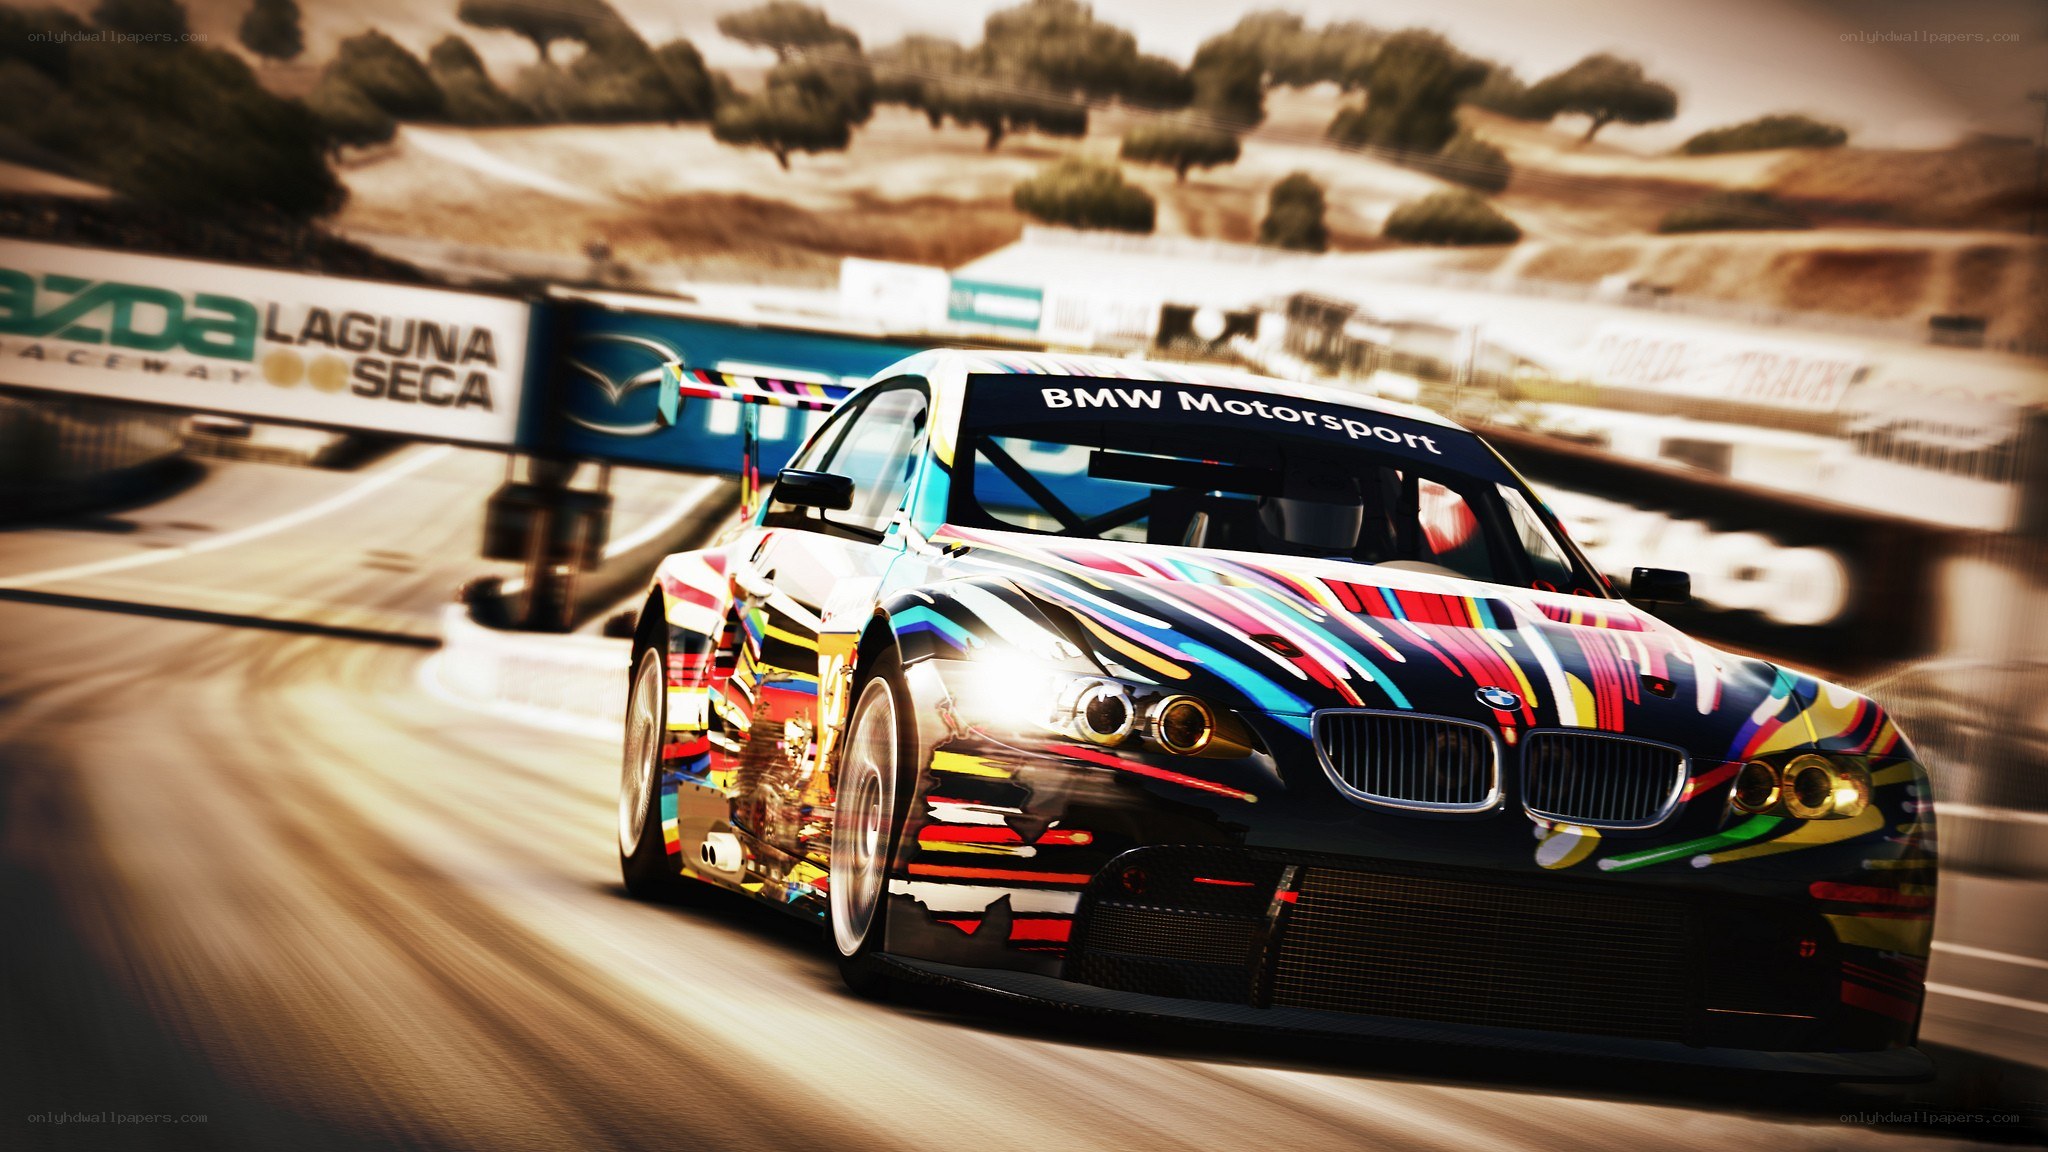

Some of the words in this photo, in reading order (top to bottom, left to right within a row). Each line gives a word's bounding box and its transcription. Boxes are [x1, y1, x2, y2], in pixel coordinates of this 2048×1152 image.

[0, 341, 250, 384] ACEWAY
[264, 302, 498, 368] LAGUNA
[352, 356, 494, 413] SECA
[1041, 388, 1162, 409] BMW
[1177, 390, 1442, 455] Motorsport
